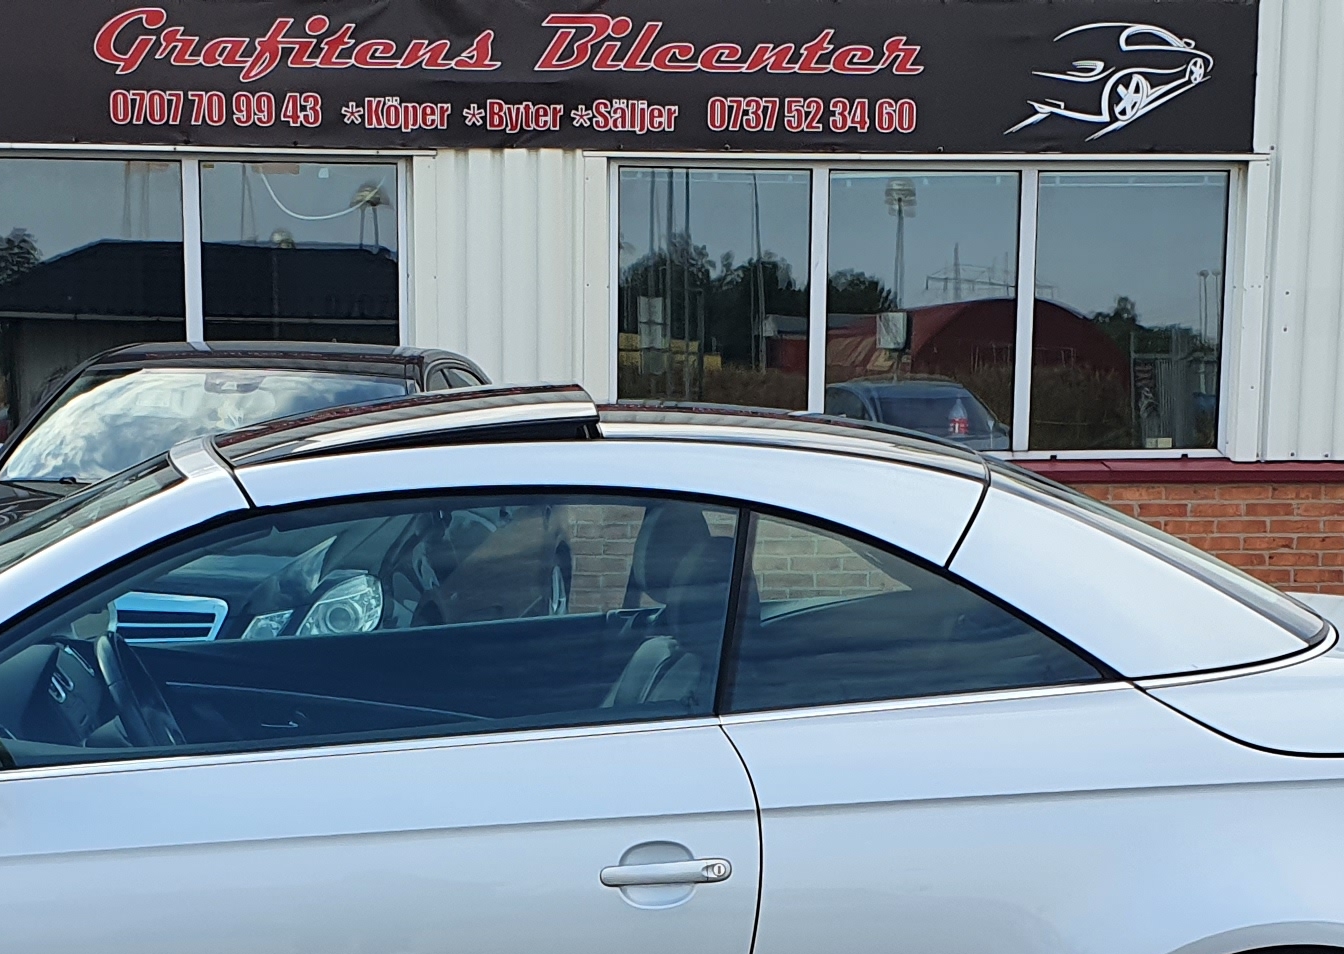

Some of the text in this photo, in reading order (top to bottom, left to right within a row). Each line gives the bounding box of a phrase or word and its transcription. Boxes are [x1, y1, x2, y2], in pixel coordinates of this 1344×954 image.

[93, 7, 925, 82] Grafitens Bilcenter
[109, 89, 184, 125] 0707
[188, 91, 227, 126] 70
[234, 92, 277, 127] 99
[280, 92, 323, 128] 43
[707, 97, 780, 132] 0737
[784, 98, 823, 132] 52
[829, 98, 869, 133] 34
[874, 99, 917, 134] 60
